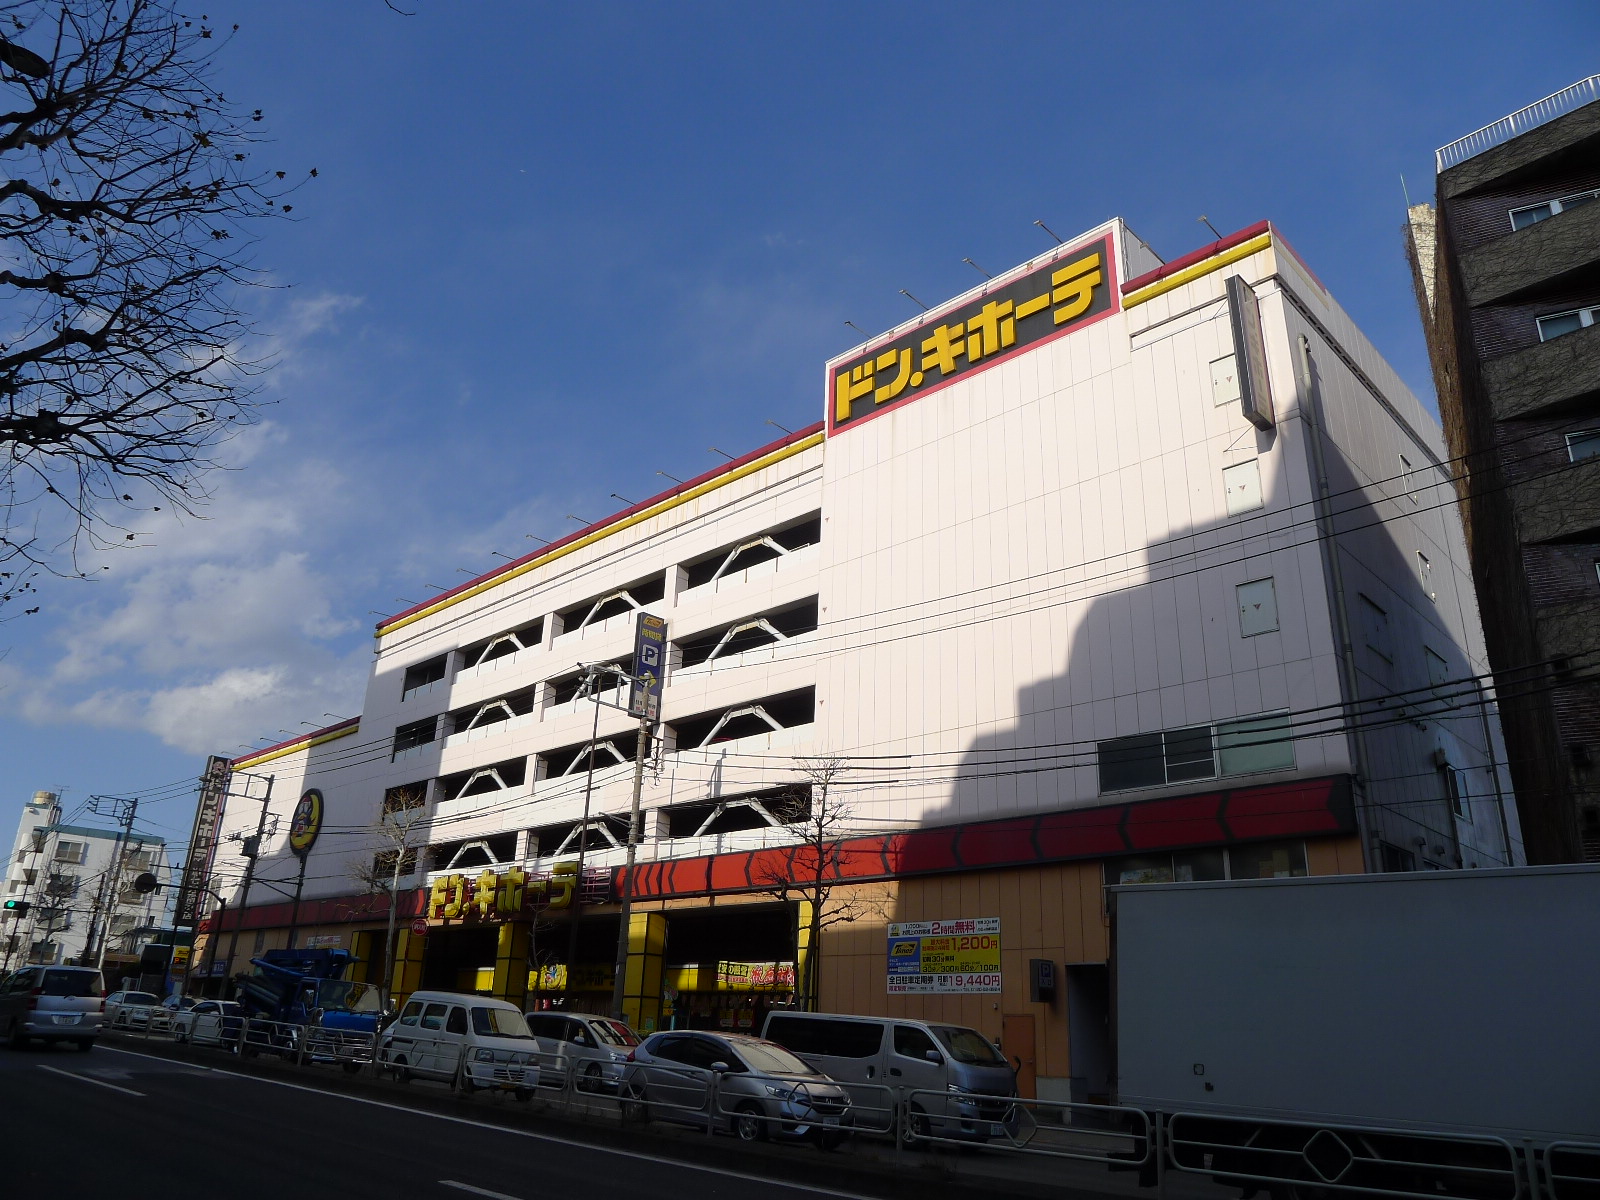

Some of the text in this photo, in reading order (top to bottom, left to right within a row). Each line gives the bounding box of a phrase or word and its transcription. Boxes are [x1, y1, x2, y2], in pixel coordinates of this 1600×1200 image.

[931, 919, 975, 935] 2時間無料
[952, 935, 998, 952] 1,200円
[949, 974, 1000, 988] 19,440円
